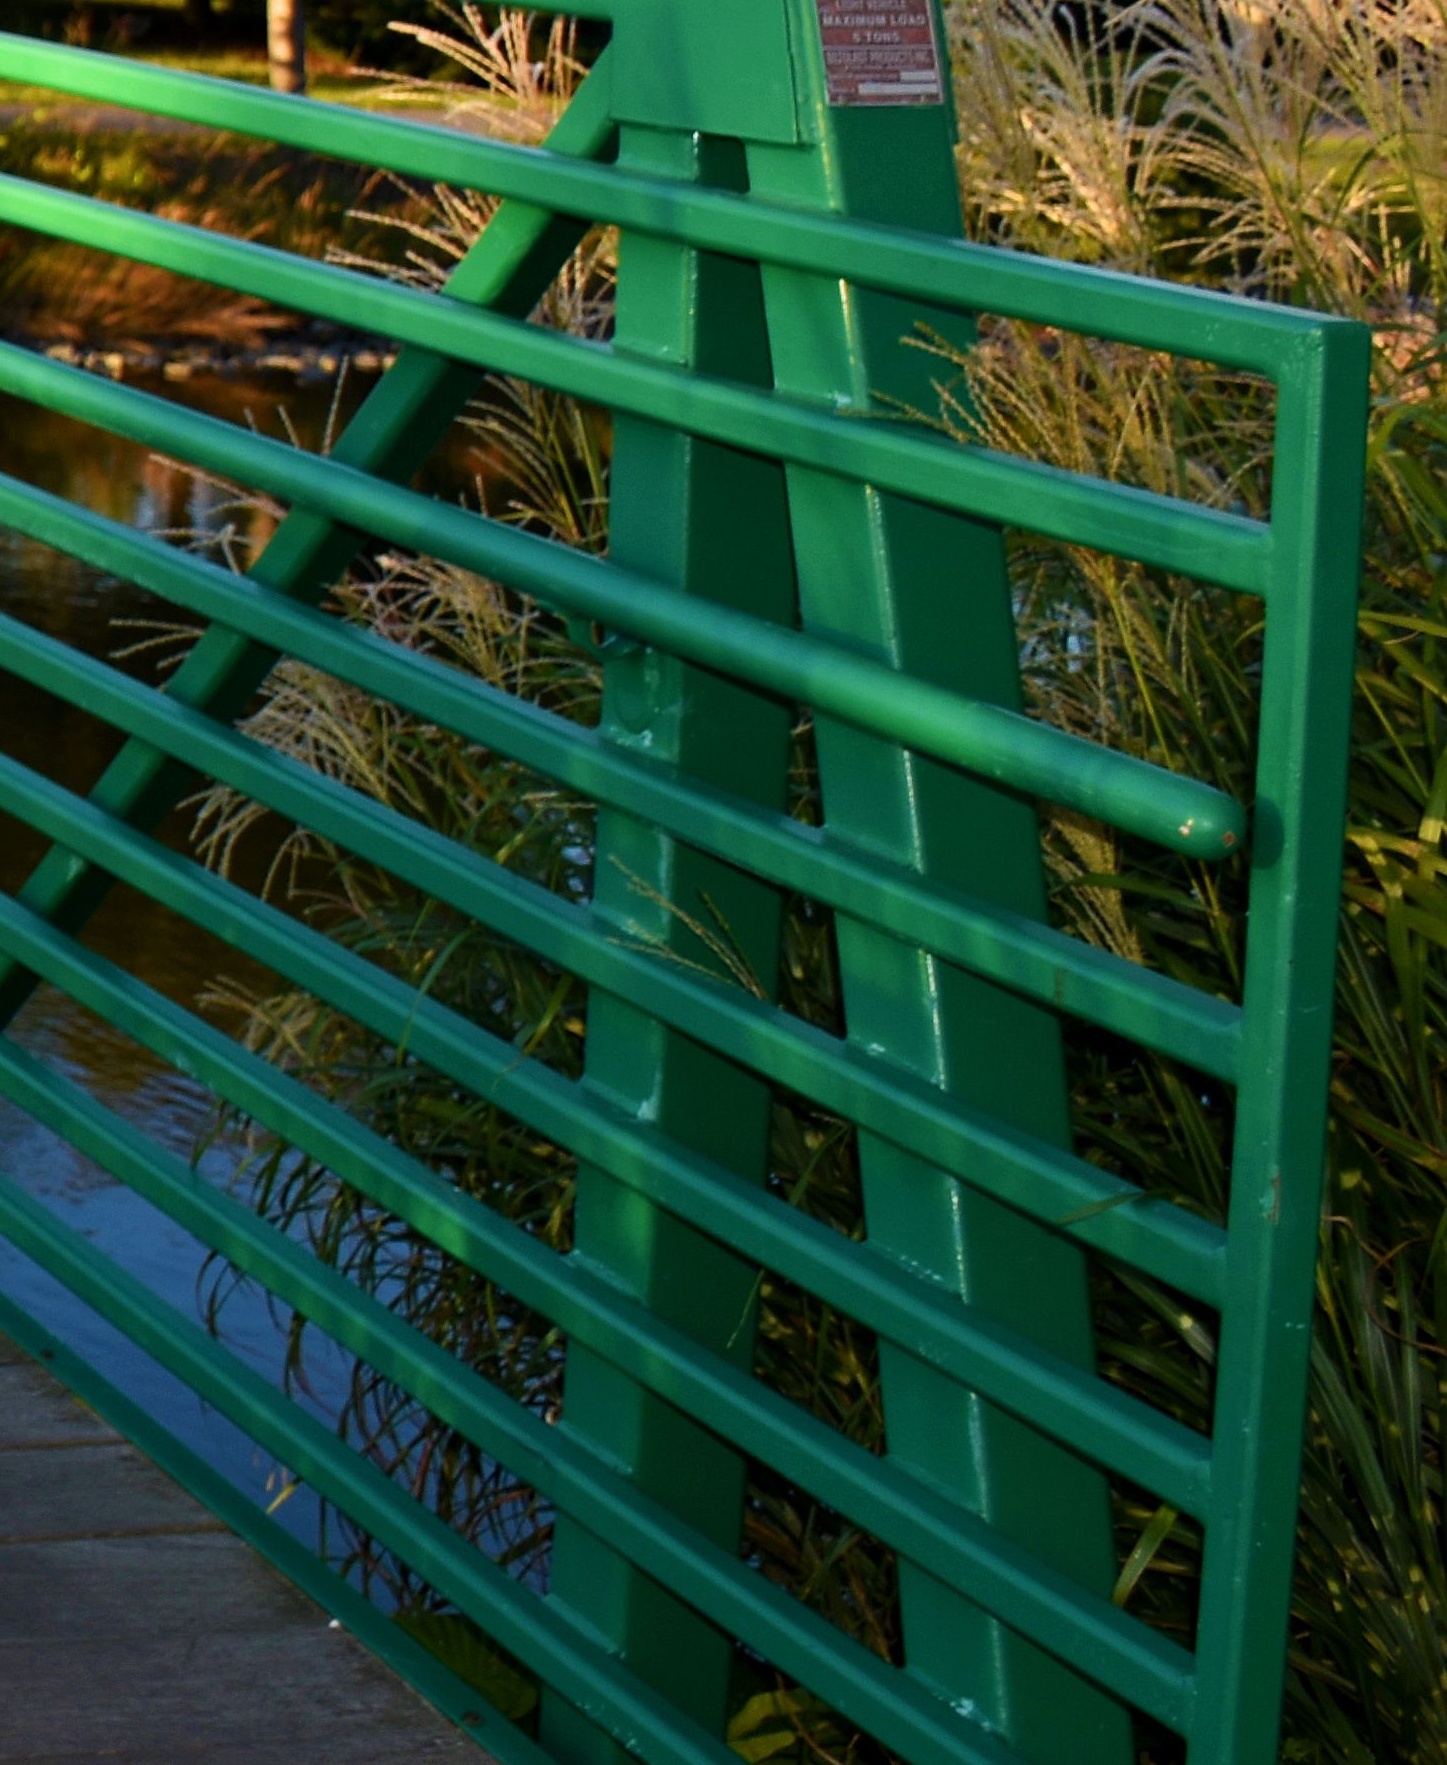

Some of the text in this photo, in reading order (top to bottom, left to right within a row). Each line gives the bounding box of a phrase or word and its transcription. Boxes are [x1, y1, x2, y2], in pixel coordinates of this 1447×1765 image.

[822, 14, 926, 27] MAXIMUM LOAD
[866, 31, 900, 43] TONS
